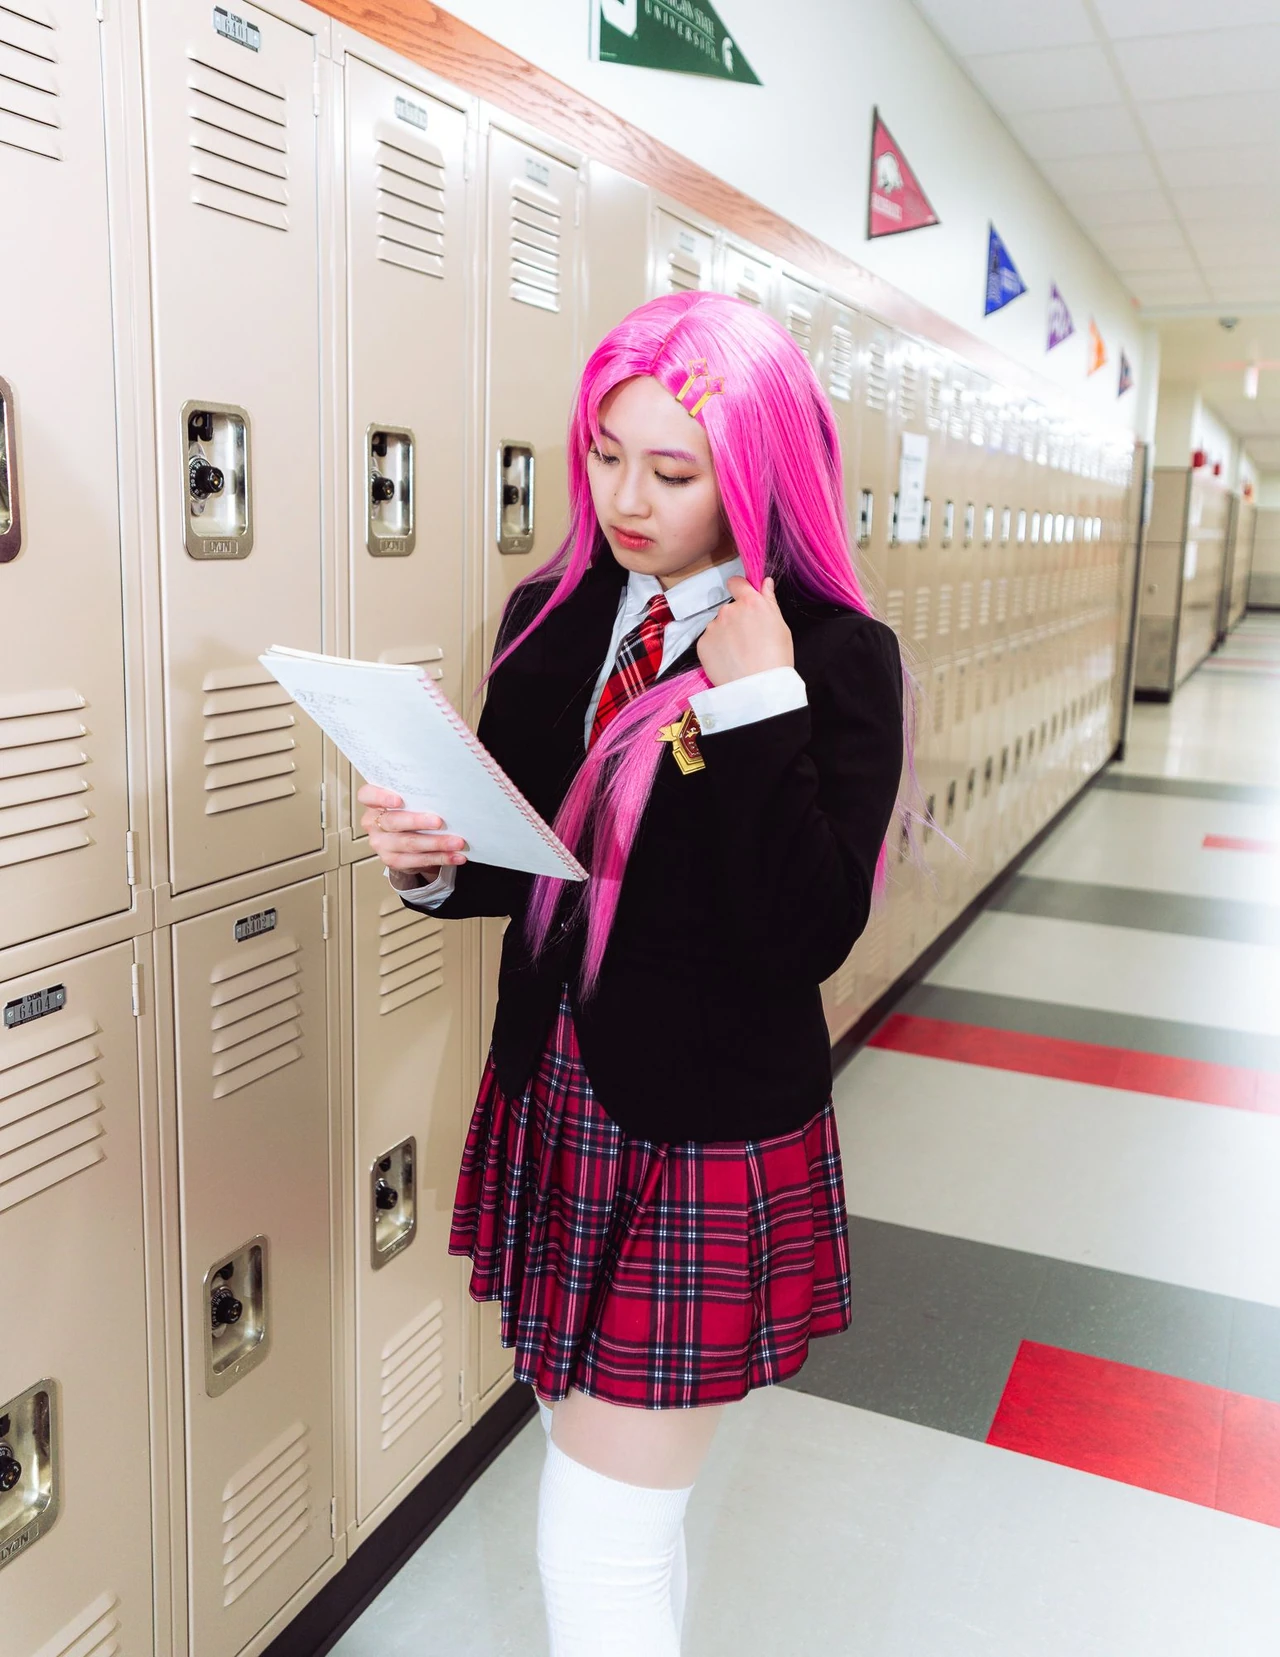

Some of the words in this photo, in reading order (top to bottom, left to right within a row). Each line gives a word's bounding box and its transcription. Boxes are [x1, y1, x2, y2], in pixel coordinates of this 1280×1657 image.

[225, 18, 248, 43] 6401
[20, 995, 50, 1020] 6404
[27, 991, 41, 1002] LYON
[1, 1530, 29, 1561] LYON
